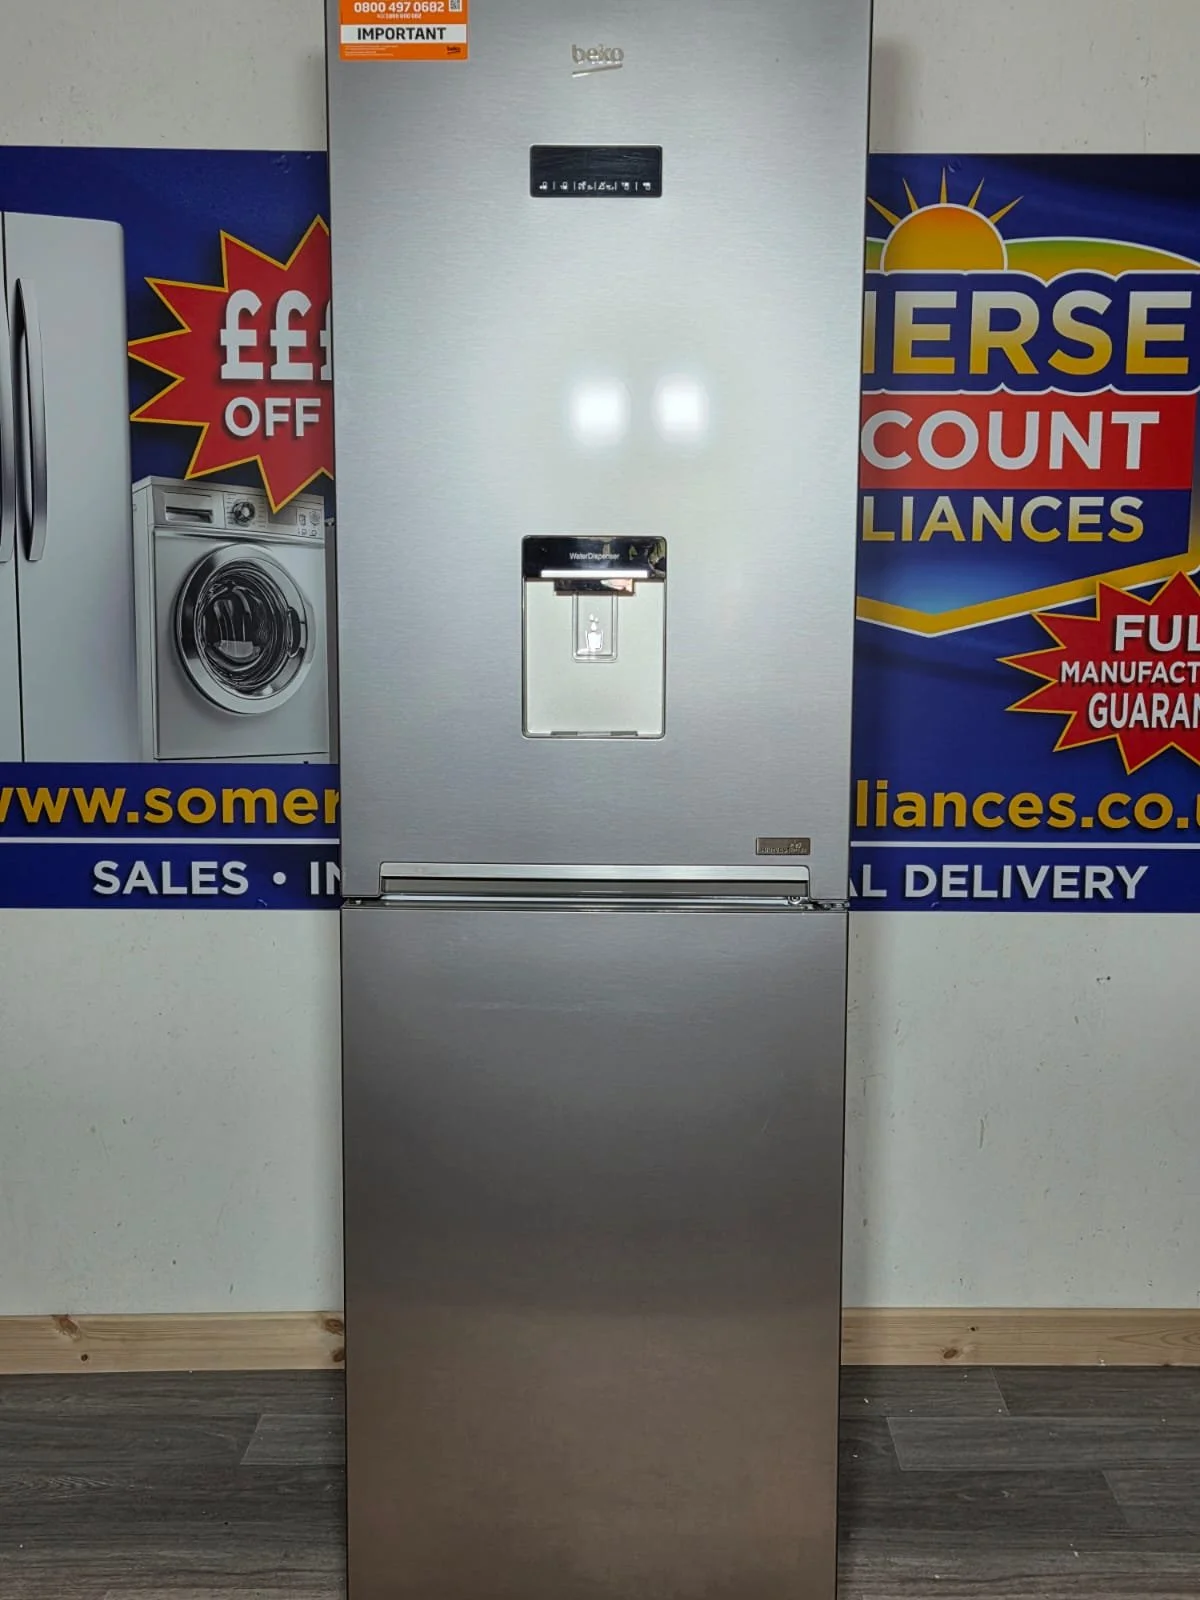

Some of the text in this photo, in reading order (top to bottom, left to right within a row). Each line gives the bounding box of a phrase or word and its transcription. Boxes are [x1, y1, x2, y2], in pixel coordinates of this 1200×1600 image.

[354, 2, 444, 13] 0800 497 0682
[357, 27, 447, 41] IMPORTANT
[571, 43, 625, 65] beko
[863, 290, 1192, 375] ERSE
[224, 396, 321, 437] OFF
[861, 410, 1160, 470] COUNT
[862, 496, 1144, 542] LIANCES
[569, 552, 620, 561] WaterDispenser
[0, 787, 339, 825] ww.somer
[856, 779, 1200, 829] liances.co.
[93, 861, 249, 895] SALES
[850, 864, 1149, 899] L DELIVERY
